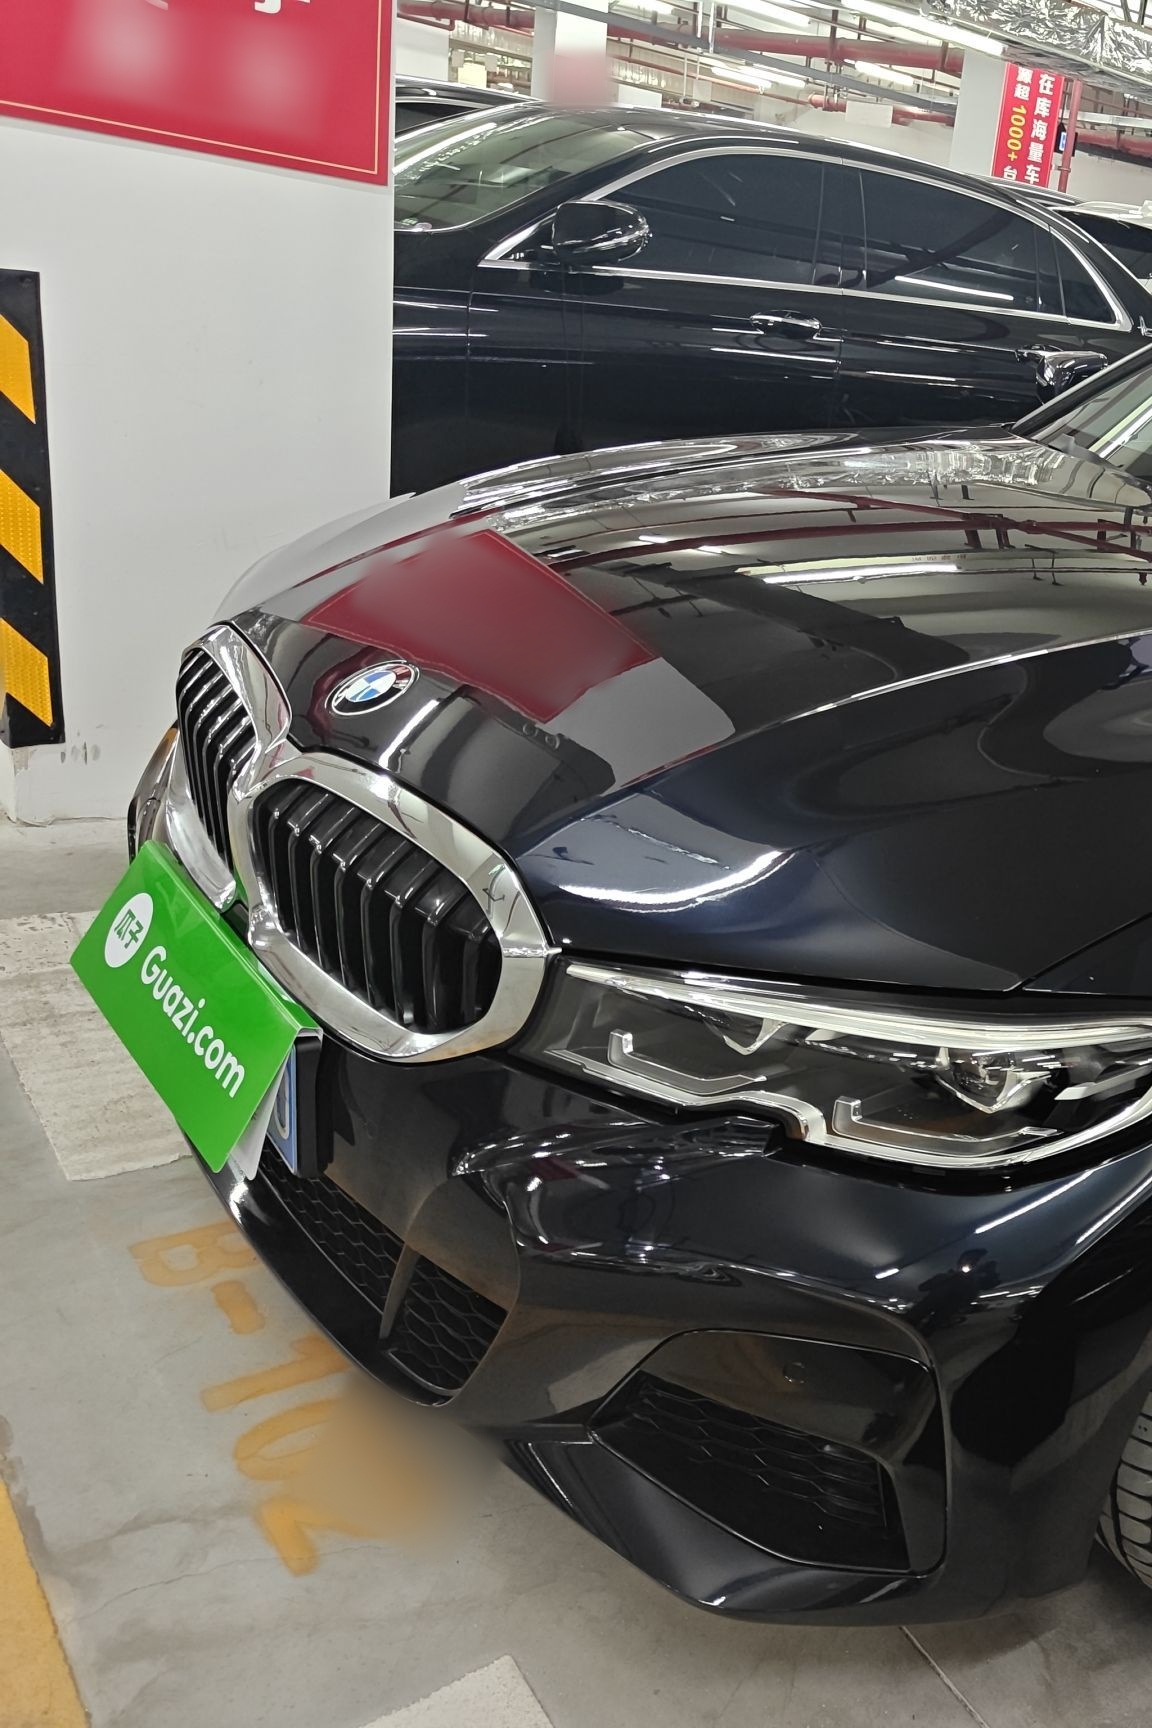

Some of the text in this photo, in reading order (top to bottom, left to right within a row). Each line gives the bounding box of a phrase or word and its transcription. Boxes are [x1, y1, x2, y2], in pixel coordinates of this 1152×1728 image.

[1024, 73, 1055, 185] 在库海量车
[114, 908, 143, 949] 瓜子
[141, 945, 245, 1098] Guazi.com
